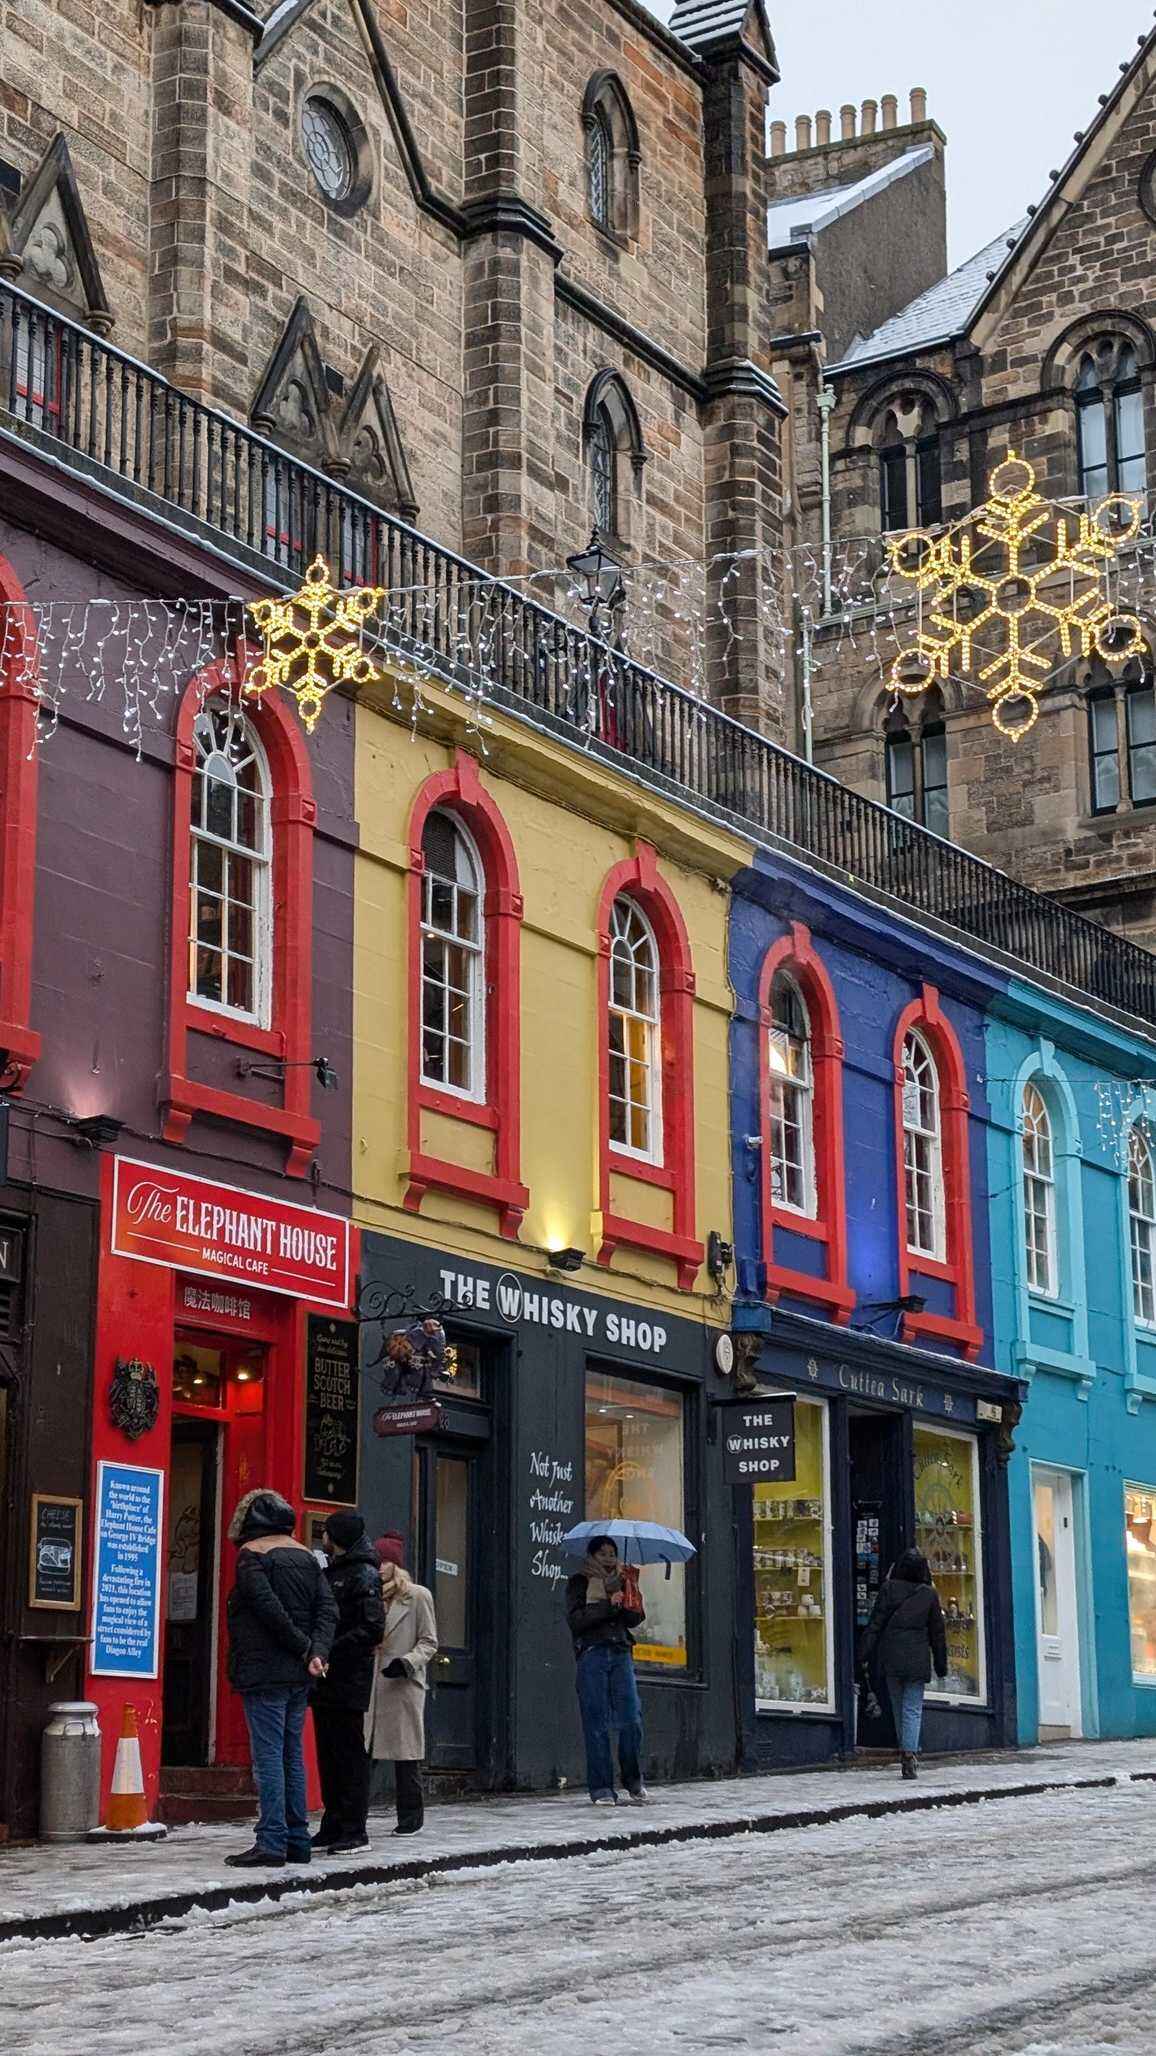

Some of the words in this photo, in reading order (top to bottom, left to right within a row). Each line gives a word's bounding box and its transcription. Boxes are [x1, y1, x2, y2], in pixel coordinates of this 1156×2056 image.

[127, 1181, 180, 1224] The
[176, 1195, 276, 1255] ELEPHANT
[279, 1222, 337, 1271] HOUSE
[202, 1247, 244, 1270] MAGICAL
[245, 1258, 269, 1275] CAFE
[184, 1286, 251, 1320] 魔法咖啡馆
[439, 1269, 490, 1310] THE
[500, 1285, 598, 1337] WHISKY
[605, 1313, 667, 1353] SHOP
[314, 1357, 350, 1378] BUTTER
[313, 1374, 351, 1395] SCOTCH
[891, 1377, 924, 1408] Sark
[319, 1392, 344, 1412] BEER
[743, 1414, 773, 1427] THE
[729, 1436, 790, 1451] WHISKY
[529, 1451, 549, 1477] Not
[549, 1461, 573, 1488] Just
[739, 1459, 780, 1473] SHOP
[109, 1490, 117, 1498] the
[142, 1495, 151, 1504] the
[530, 1488, 574, 1514] Another
[106, 1509, 122, 1520] Harry
[143, 1515, 152, 1524] the
[101, 1519, 126, 1531] Elephant
[127, 1523, 143, 1532] House
[530, 1519, 564, 1545] Whisk
[108, 1530, 128, 1542] George
[119, 1543, 149, 1553] established
[118, 1551, 124, 1560] in
[125, 1552, 138, 1561] 1995
[112, 1564, 138, 1576] Following
[102, 1574, 133, 1585] devastating
[144, 1577, 151, 1586] in
[118, 1586, 128, 1594] this
[129, 1586, 151, 1596] location
[110, 1597, 129, 1606] opened
[104, 1604, 114, 1613] fans
[123, 1607, 137, 1617] enjoy
[138, 1608, 147, 1616] the
[102, 1615, 123, 1625] magical
[125, 1616, 136, 1625] view
[98, 1625, 113, 1633] street
[114, 1626, 144, 1636] considered
[100, 1634, 111, 1643] fans
[127, 1637, 136, 1645] the
[128, 1646, 141, 1658] Alley
